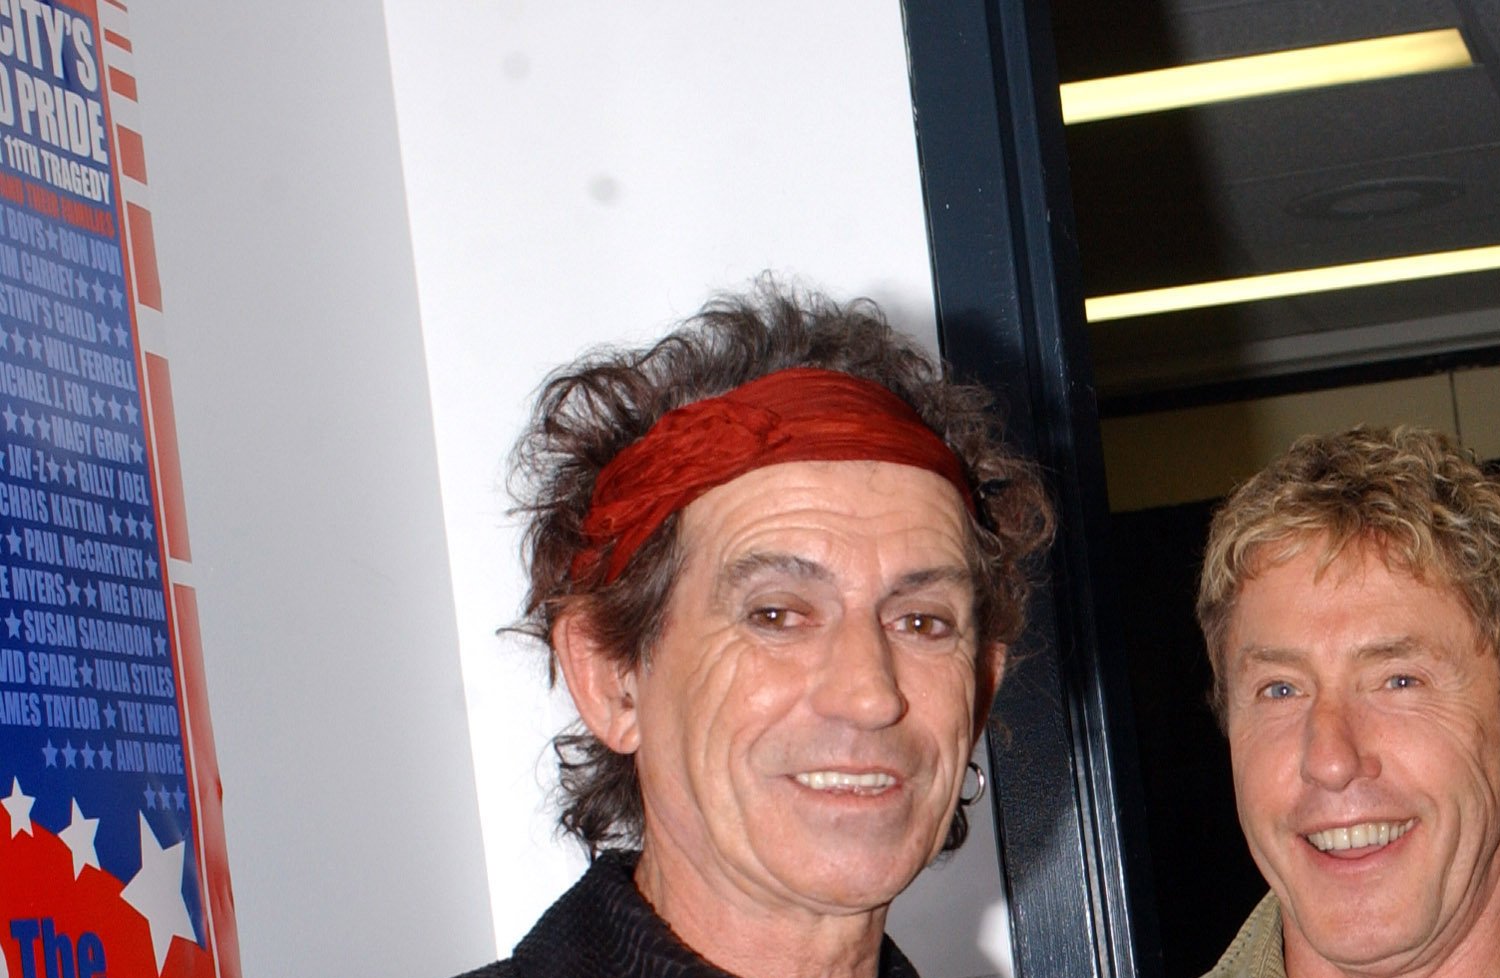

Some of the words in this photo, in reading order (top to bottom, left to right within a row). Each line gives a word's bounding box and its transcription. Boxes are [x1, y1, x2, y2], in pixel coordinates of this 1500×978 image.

[15, 68, 109, 165] PRIDE
[4, 134, 41, 179] 11TH
[41, 148, 110, 205] TRAGEDY
[6, 206, 46, 251] BOYS
[58, 226, 90, 267] BON
[89, 238, 122, 277] JOVI
[0, 240, 20, 279] IM
[20, 249, 75, 299] CARREY
[53, 300, 97, 342] CHILD
[0, 361, 53, 407] ICHAEL
[52, 376, 65, 411] J.
[63, 380, 93, 418] FOX
[42, 335, 80, 376] WILL
[78, 346, 137, 392] FERRELL
[50, 415, 92, 456] MACY
[93, 426, 131, 464] GRAY
[8, 443, 48, 483] JAY-Z
[77, 460, 115, 499] BILLY
[117, 469, 149, 506] JOEL
[0, 481, 48, 524] CHRIS
[50, 493, 107, 535] KATTAN
[23, 527, 64, 566] PAUL
[62, 534, 145, 580] McCARTNEY
[11, 566, 67, 607] MYERS
[98, 580, 130, 616] MEG
[130, 585, 166, 621] RYAN
[23, 609, 79, 649] SUSAN
[78, 616, 154, 658] SARANDON
[28, 651, 80, 689] SPADE
[94, 658, 132, 694] JULIA
[130, 662, 175, 699] STILES
[42, 693, 101, 730] TAYLOR
[118, 700, 145, 734] THE
[144, 702, 180, 737] WHO
[115, 739, 145, 772] AND
[144, 741, 184, 776] MORE
